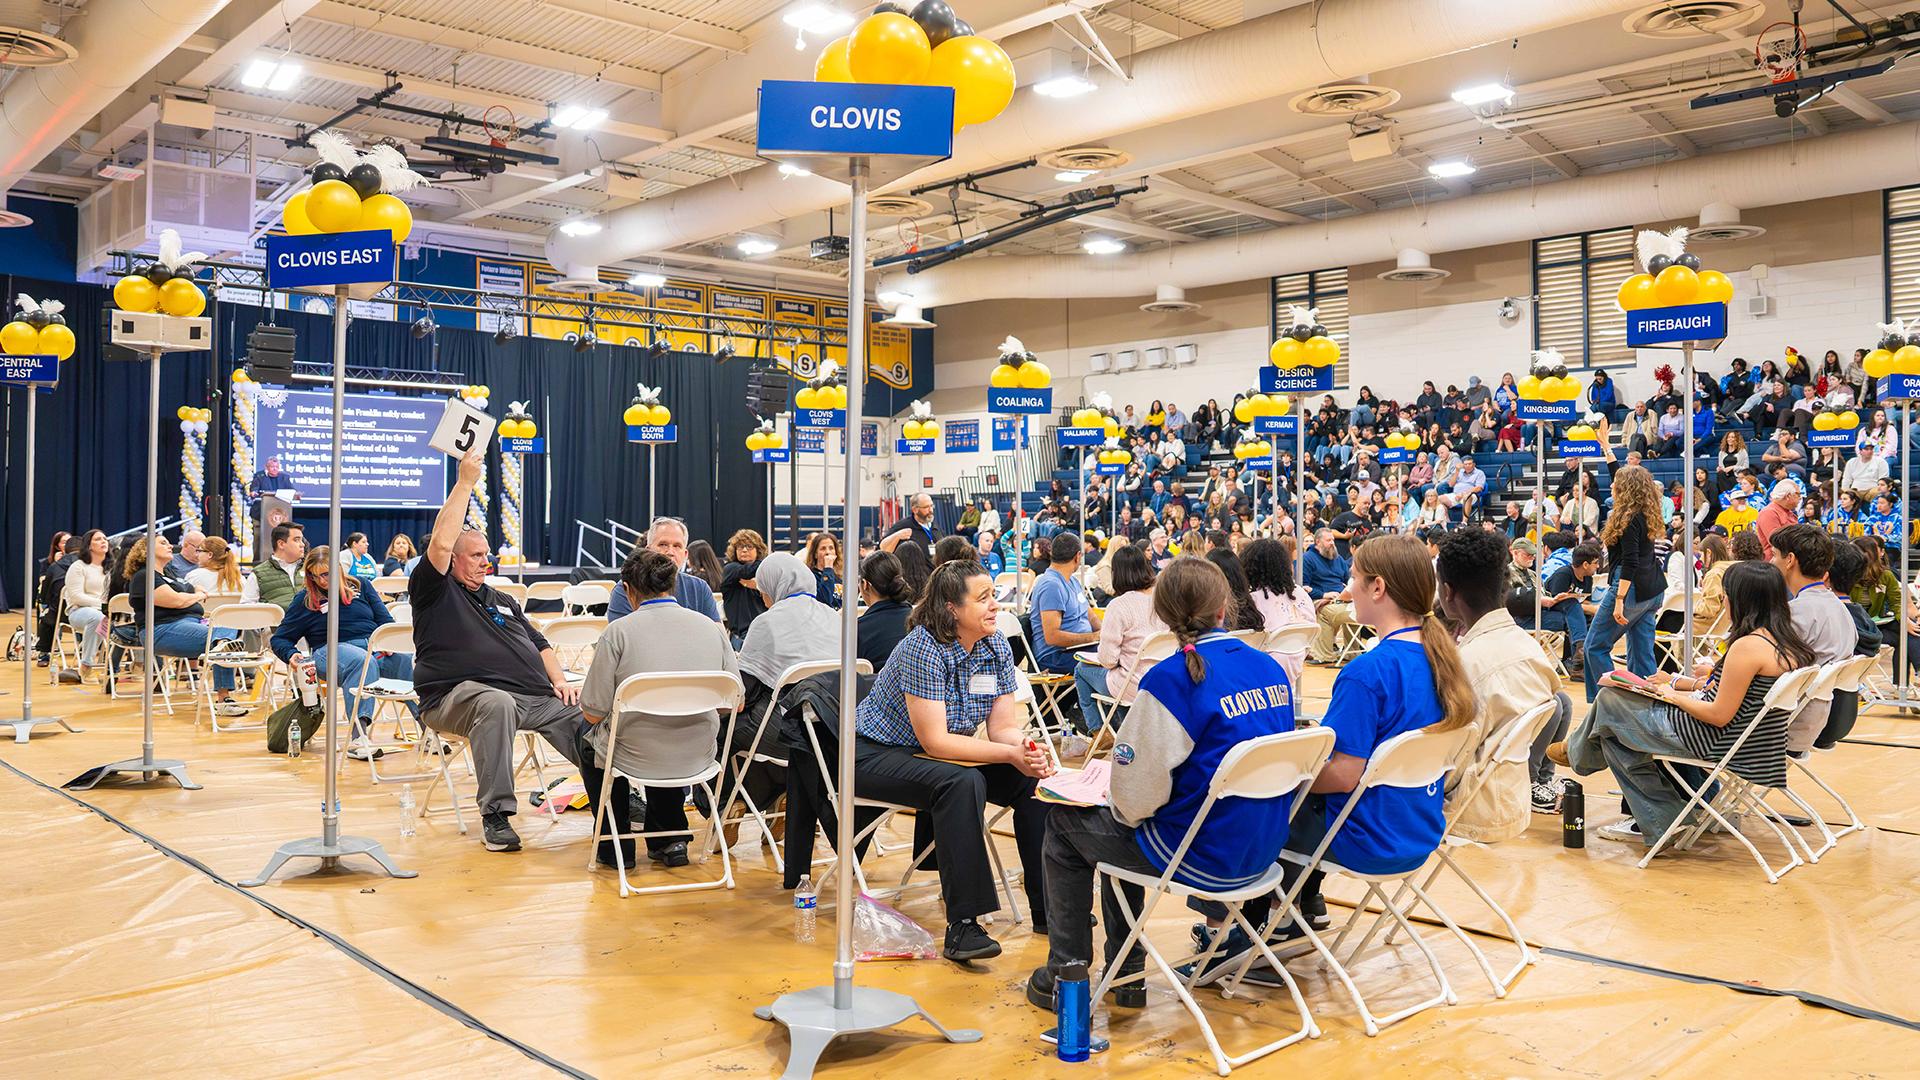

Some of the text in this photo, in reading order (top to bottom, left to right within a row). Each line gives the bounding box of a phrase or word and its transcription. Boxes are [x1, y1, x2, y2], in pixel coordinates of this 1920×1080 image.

[811, 106, 901, 131] CLOVIS
[278, 251, 337, 268] CLOVIS
[341, 249, 382, 264] EAST
[1638, 316, 1711, 333] FIREBAUGH
[802, 357, 809, 371] S
[7, 369, 32, 378] EAST
[895, 365, 902, 380] S
[1278, 368, 1314, 377] DESIGN
[1275, 379, 1317, 389] SCIENCE
[996, 397, 1044, 407] COALINGA
[277, 409, 285, 419] 7
[809, 410, 833, 418] CLOVIS
[1265, 421, 1293, 429] KERMAN
[455, 414, 480, 452] 5
[1220, 688, 1267, 719] CLOVIS
